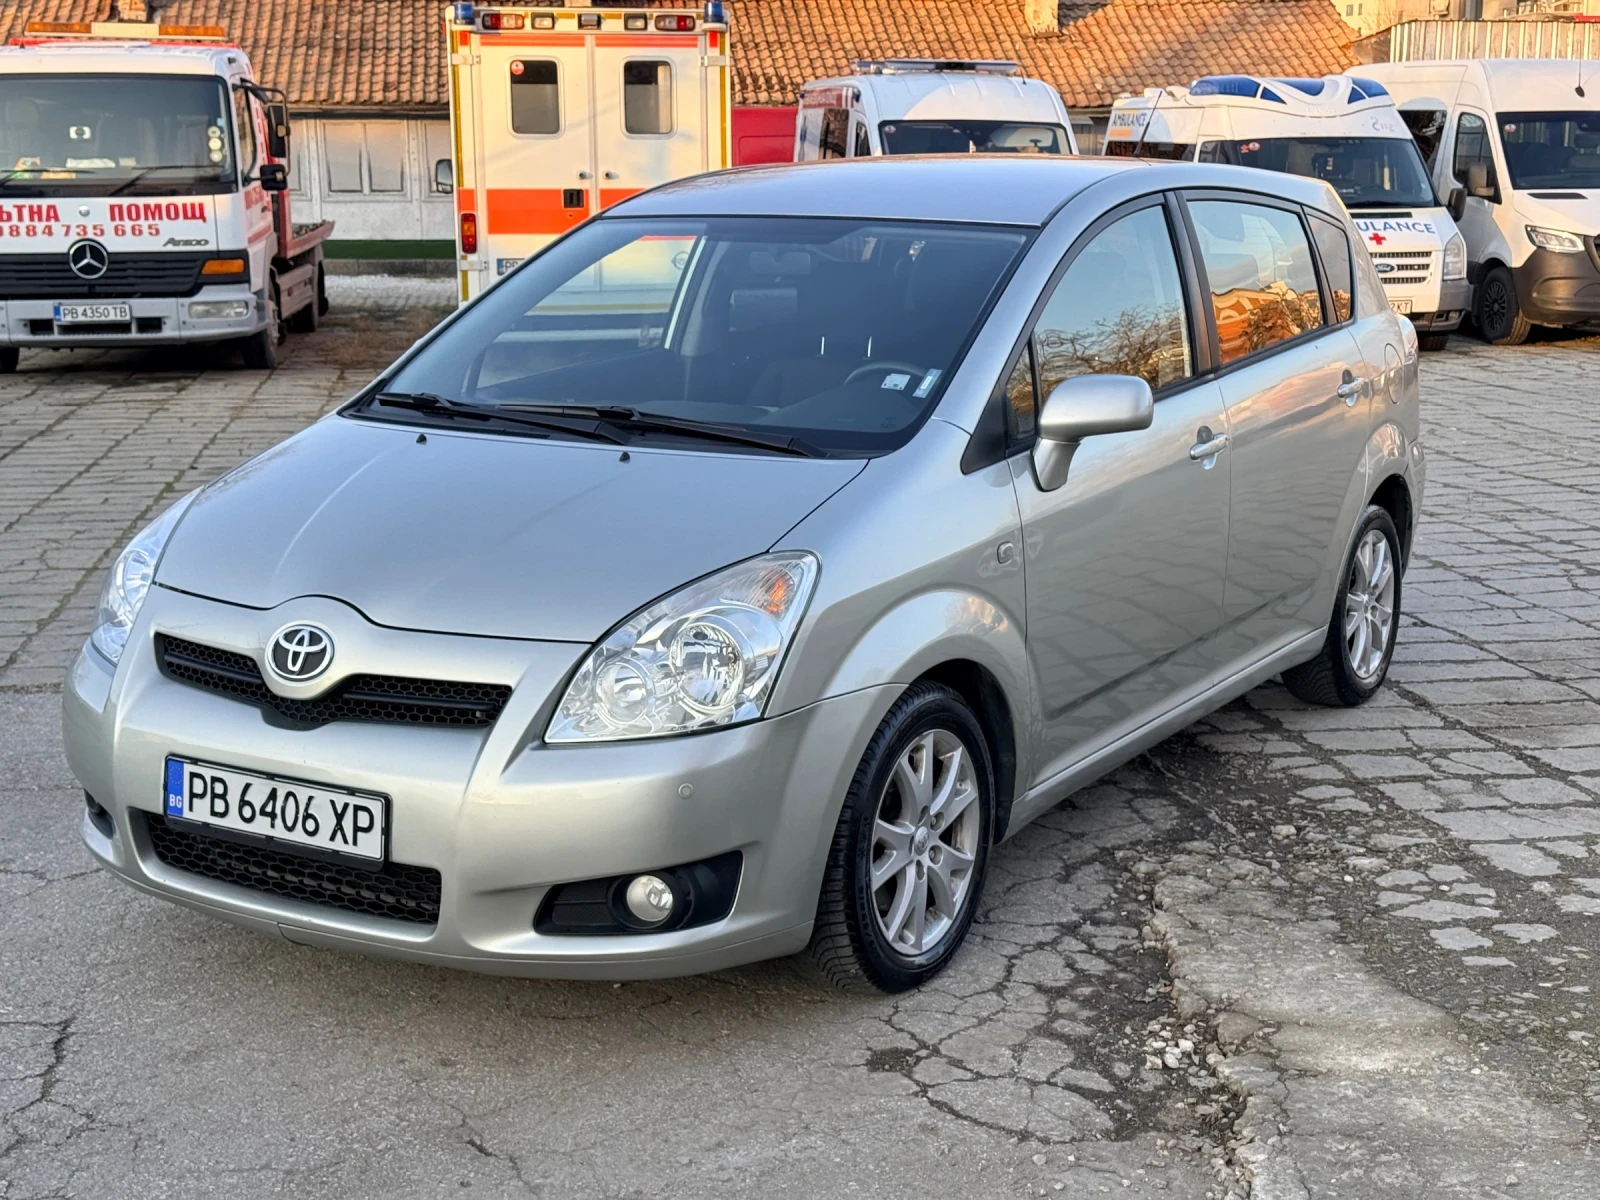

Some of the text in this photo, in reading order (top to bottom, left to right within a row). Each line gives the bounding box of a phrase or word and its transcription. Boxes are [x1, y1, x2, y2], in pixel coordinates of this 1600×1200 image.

[109, 202, 207, 223] ПОМОЩ
[61, 224, 105, 237] 735
[114, 223, 160, 237] 665
[62, 307, 79, 319] PB
[81, 307, 110, 319] 4350
[112, 306, 128, 318] TB
[169, 793, 182, 809] BG
[188, 771, 375, 847] PB 6406 XP
